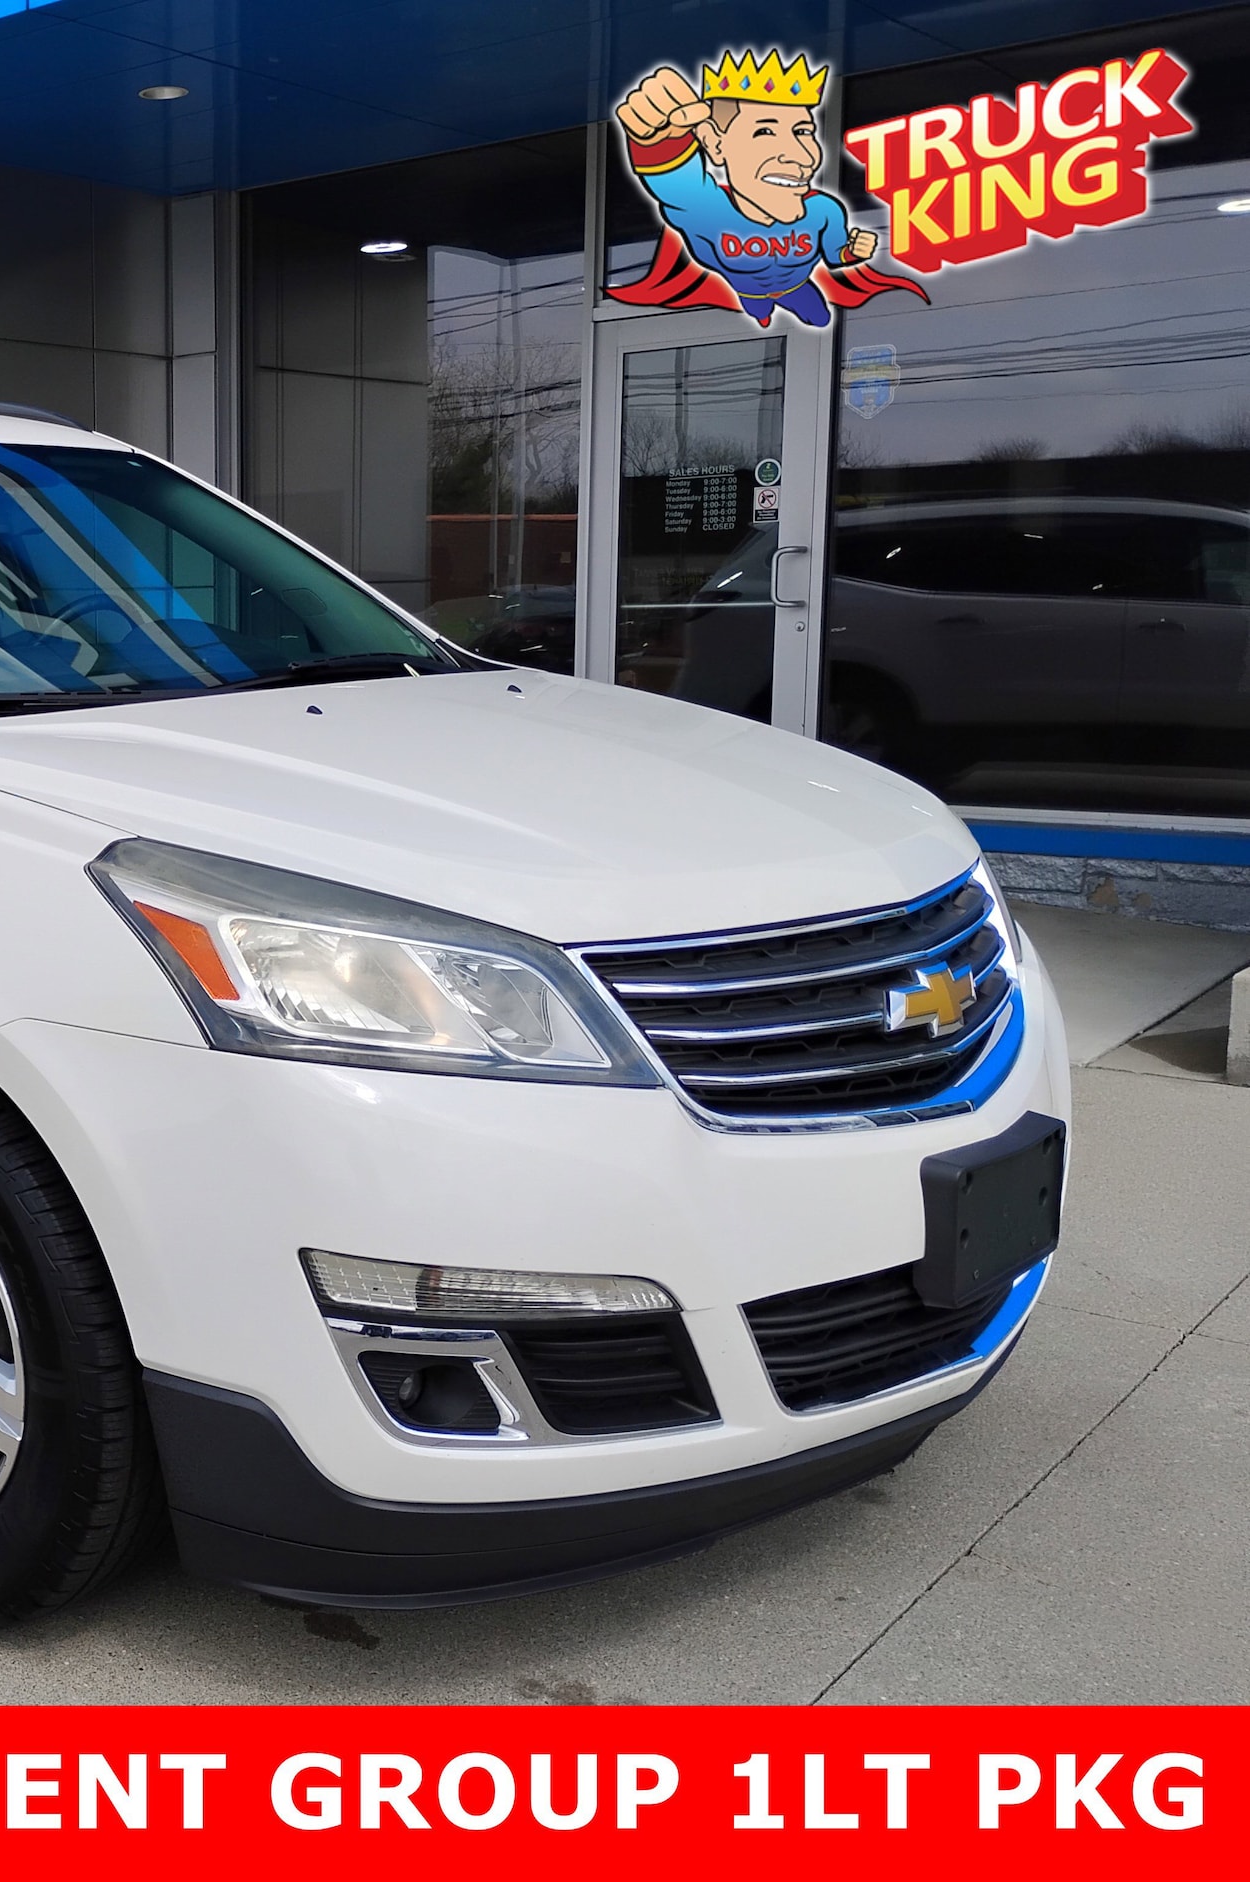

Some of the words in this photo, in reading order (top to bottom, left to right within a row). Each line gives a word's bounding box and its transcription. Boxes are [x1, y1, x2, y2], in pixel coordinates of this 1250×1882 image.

[669, 467, 699, 478] SALES
[701, 465, 735, 475] HOURS
[666, 480, 691, 488] Monday
[703, 477, 737, 486] 9:00-7:00
[665, 495, 702, 503] Wednesday
[665, 511, 685, 519] Friday
[702, 523, 735, 531] CLOSED
